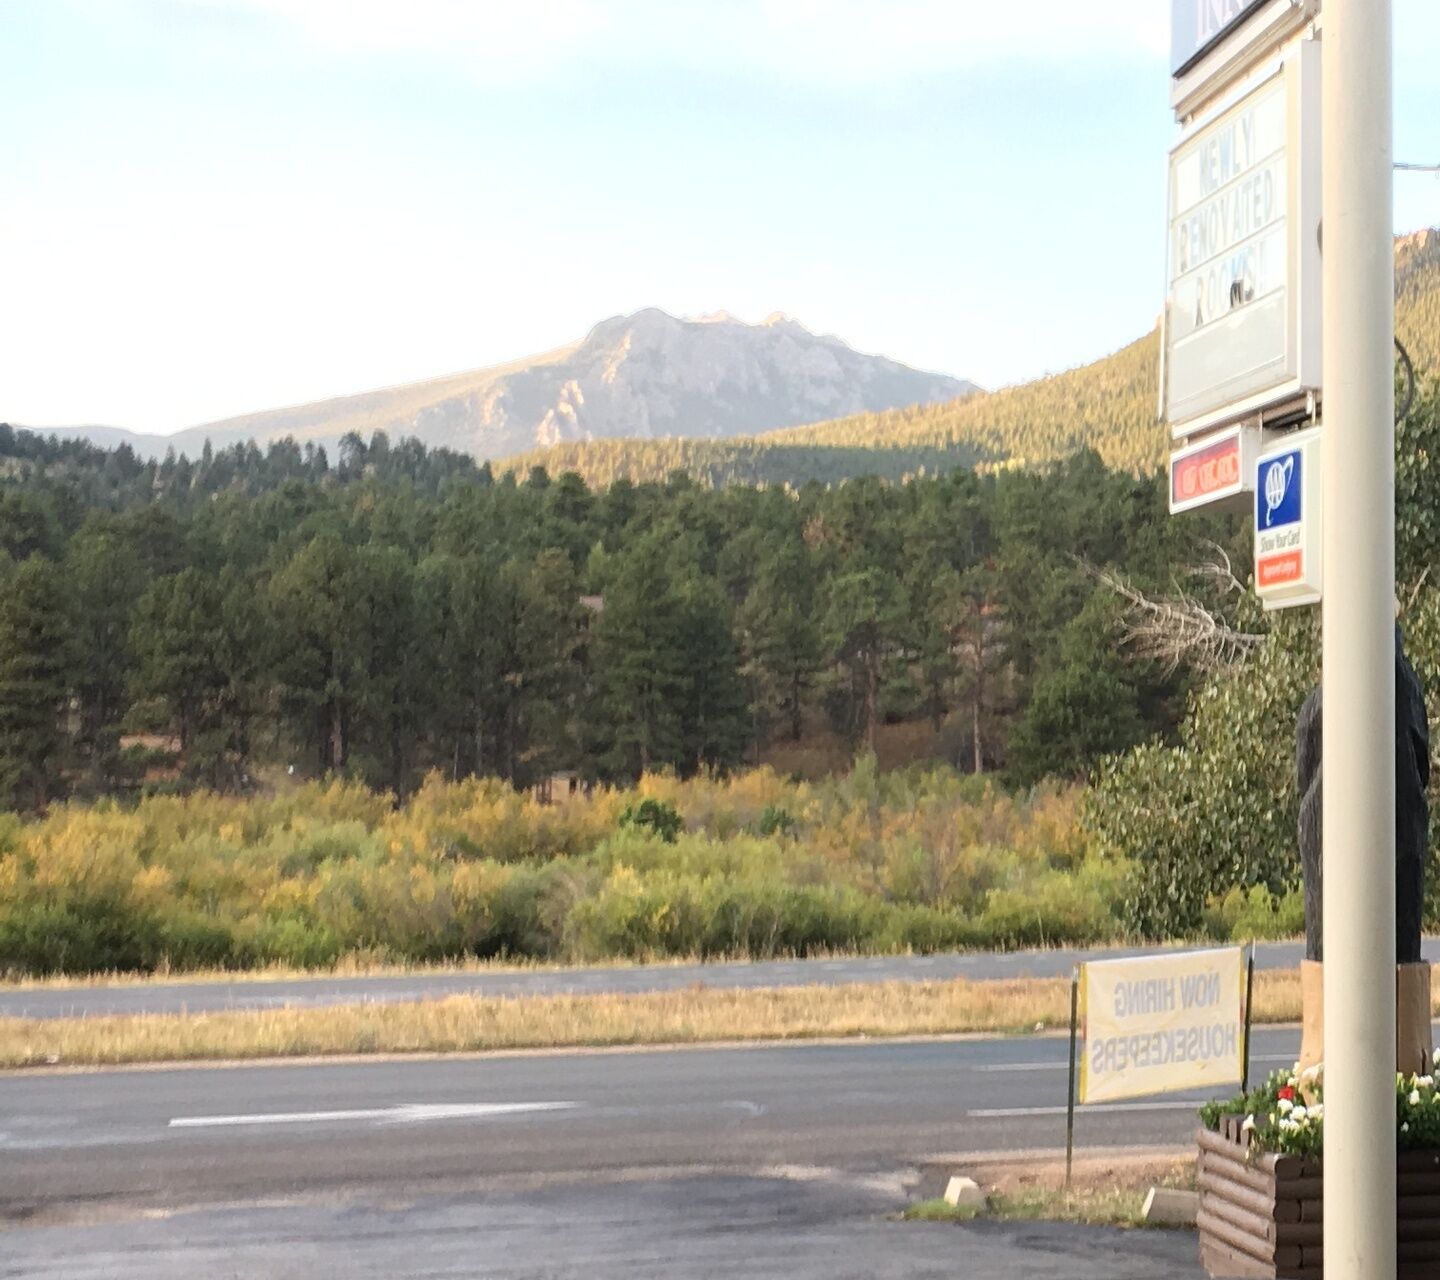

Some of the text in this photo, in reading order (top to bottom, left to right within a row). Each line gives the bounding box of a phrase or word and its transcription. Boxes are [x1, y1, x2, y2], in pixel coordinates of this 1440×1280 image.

[1199, 111, 1255, 196] NEWLY
[1179, 168, 1273, 273] RENOVATED
[1260, 528, 1301, 553] Show Your Card
